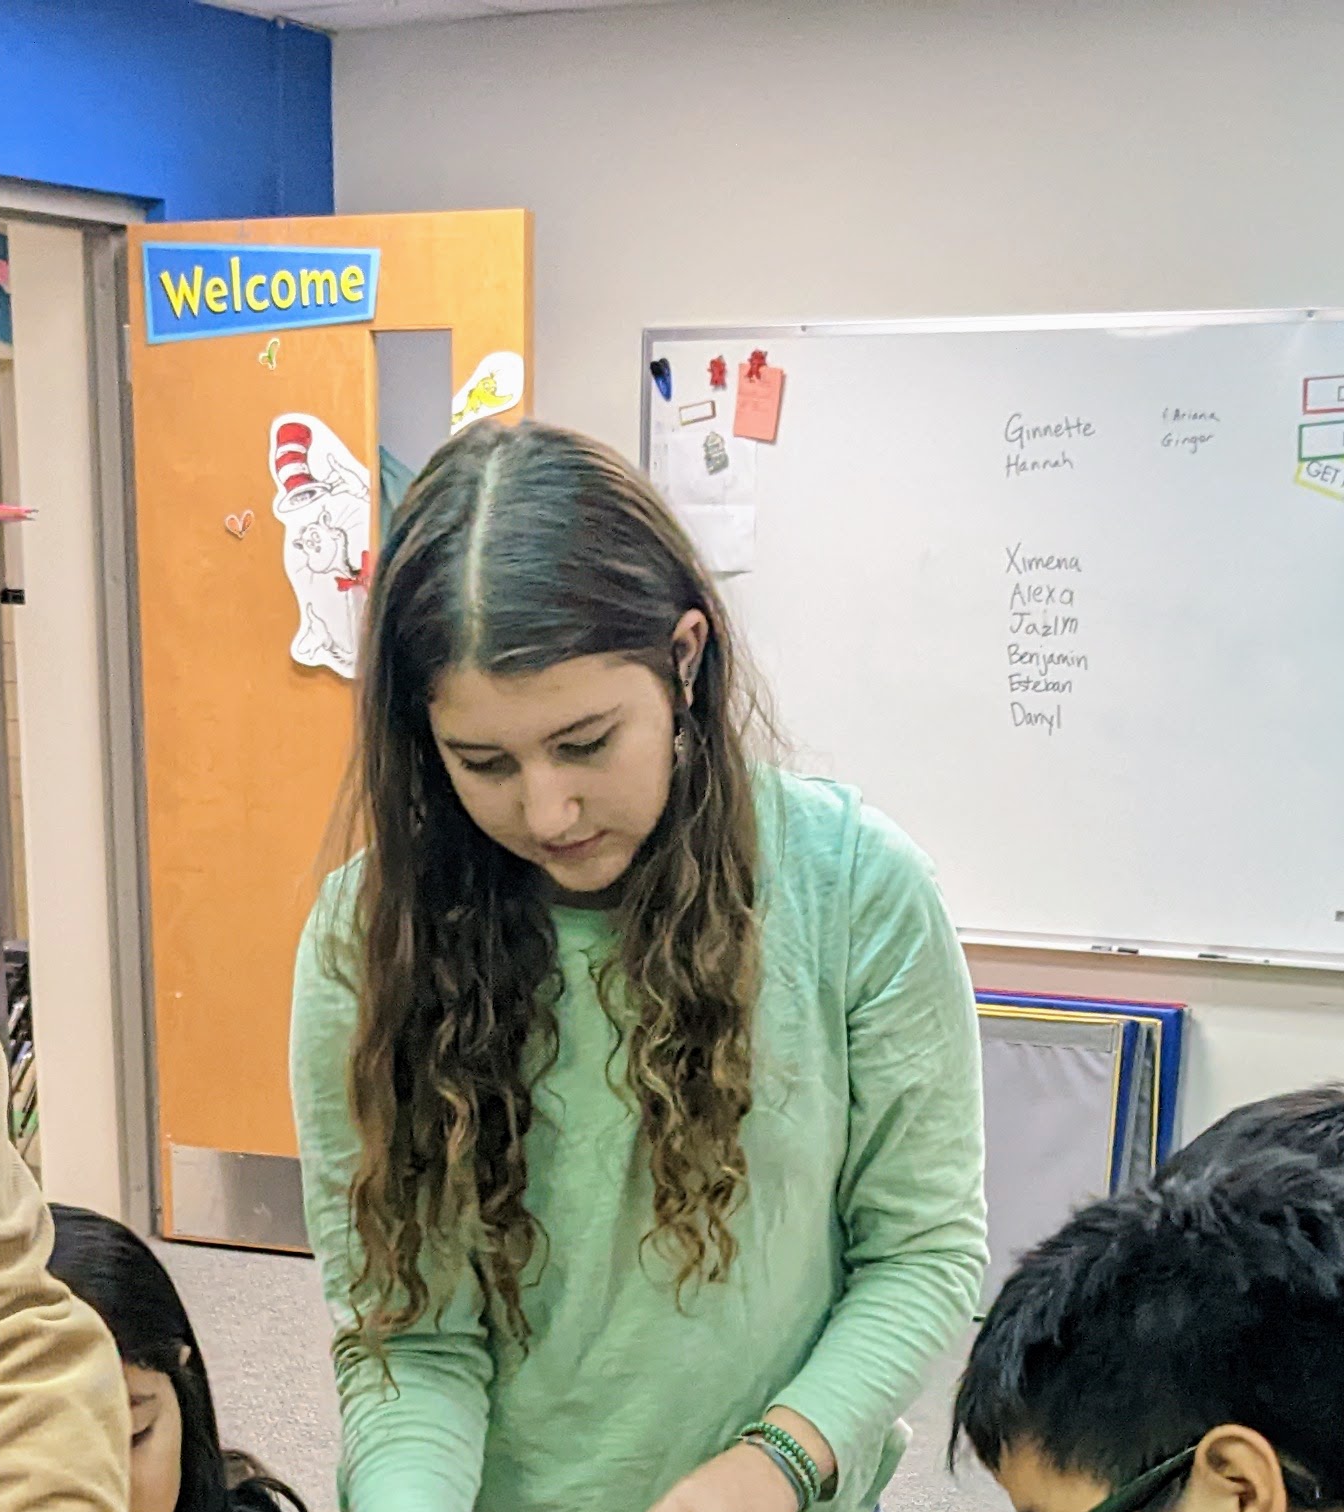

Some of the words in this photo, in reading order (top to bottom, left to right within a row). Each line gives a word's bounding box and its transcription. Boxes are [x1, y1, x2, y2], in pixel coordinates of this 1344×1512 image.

[159, 256, 365, 319] Welcome
[1005, 413, 1096, 449] Ginnette
[1005, 451, 1074, 478] Hannah
[1306, 459, 1341, 484] GET
[1005, 542, 1082, 575] Ximena
[1010, 583, 1074, 611] Alexa
[1008, 643, 1088, 676] Benjamin
[1008, 673, 1072, 693] Esteban
